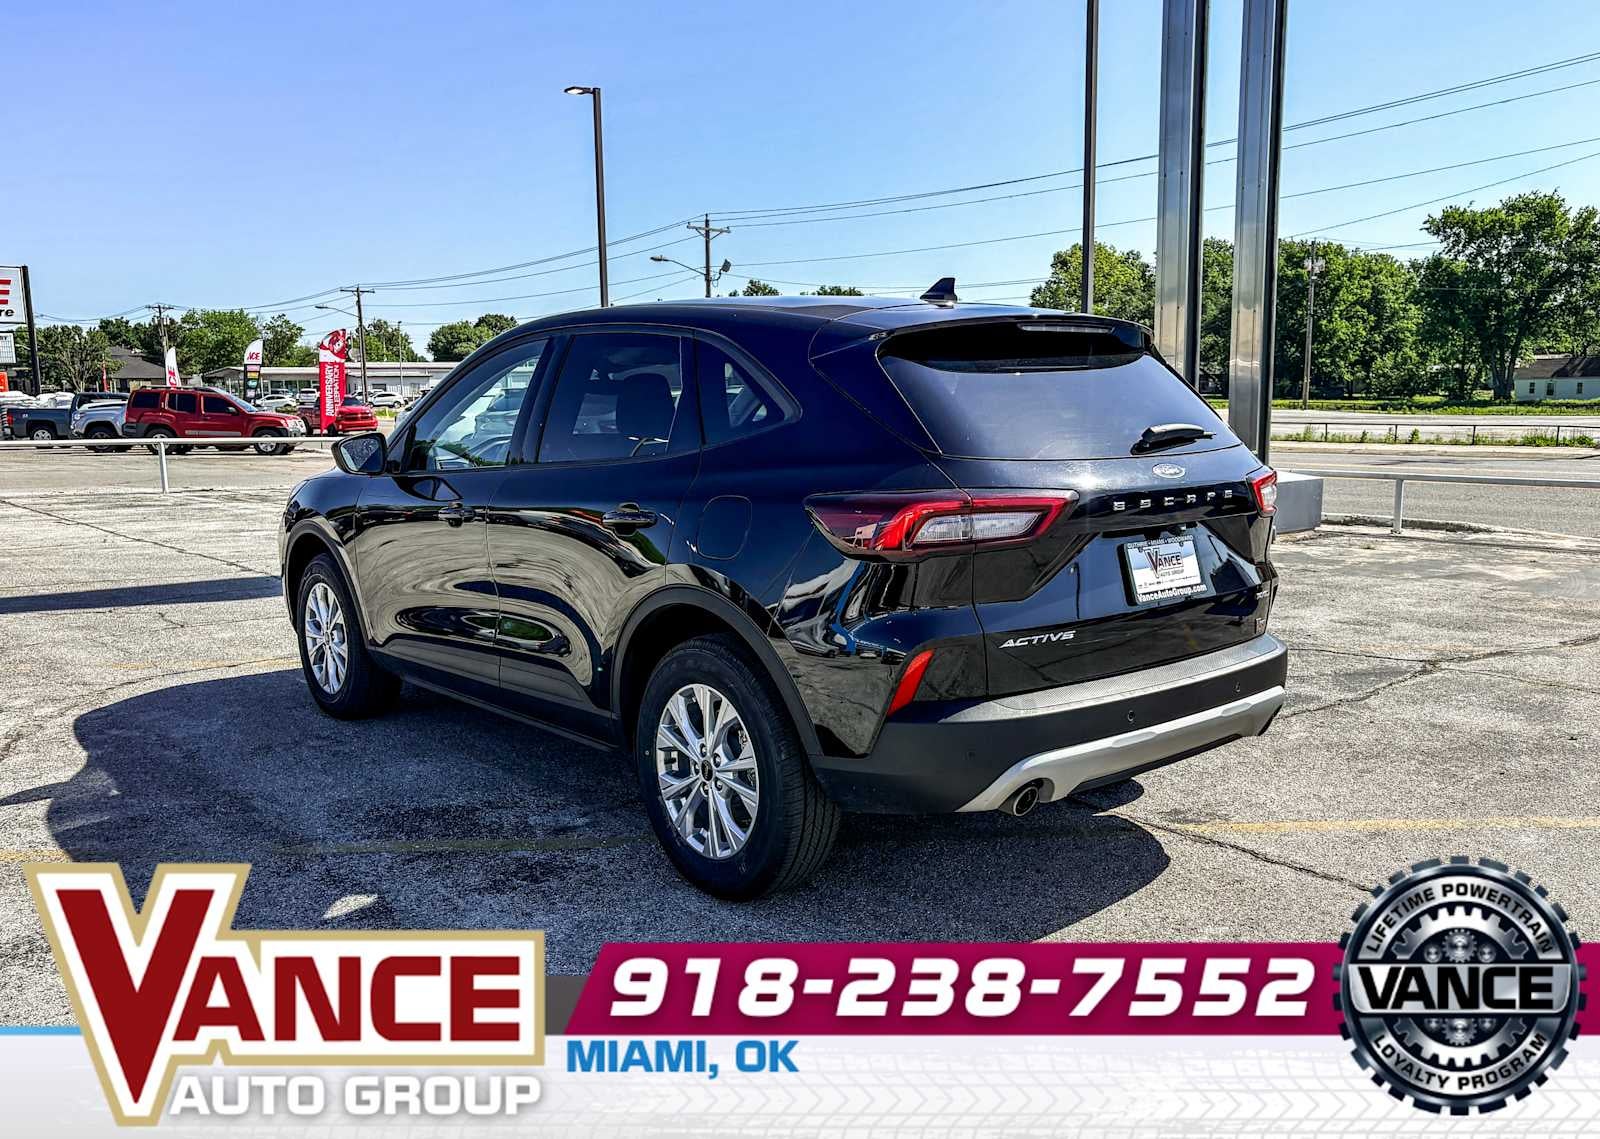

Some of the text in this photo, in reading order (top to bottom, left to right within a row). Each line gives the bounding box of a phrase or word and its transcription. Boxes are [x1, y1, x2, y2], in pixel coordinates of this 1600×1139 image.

[325, 364, 334, 417] ANNIVERSARY
[1113, 490, 1232, 511] ESCAPE
[1146, 548, 1181, 574] VANCE
[1137, 584, 1207, 602] VanceAutoGroup.com
[999, 630, 1076, 648] ACTIVE
